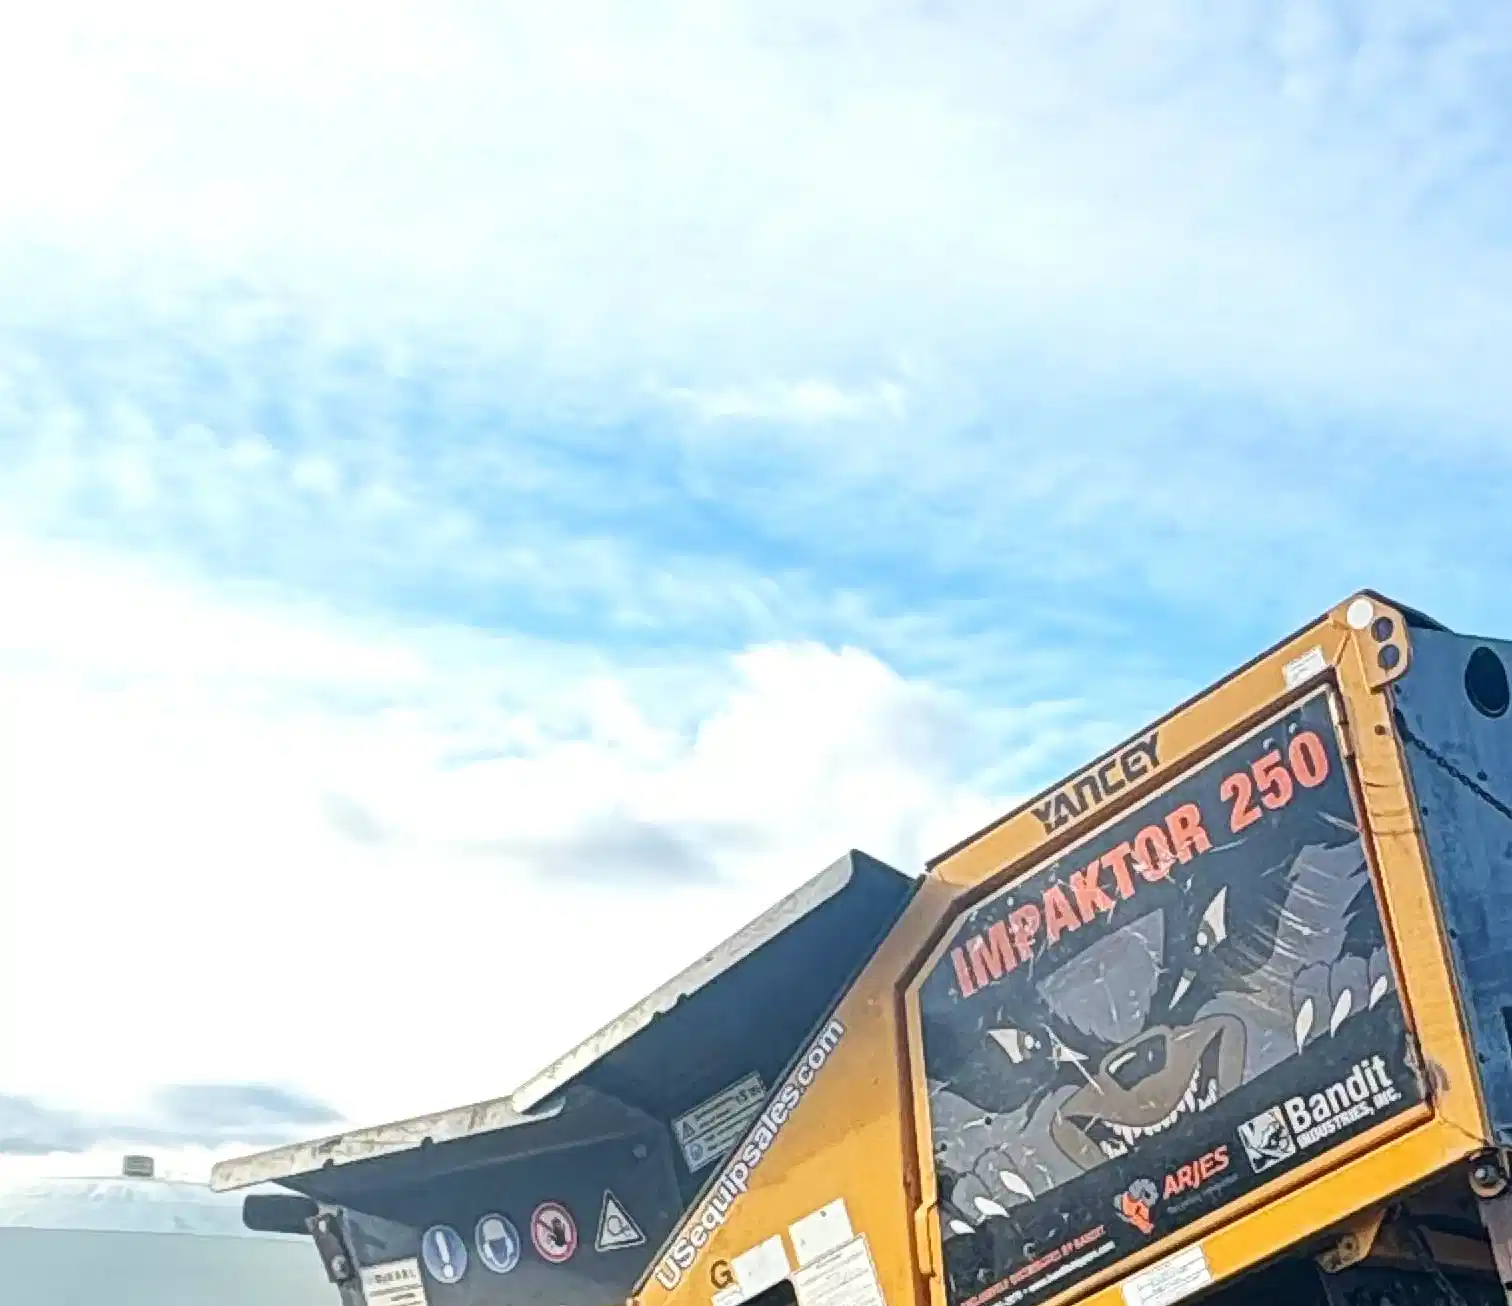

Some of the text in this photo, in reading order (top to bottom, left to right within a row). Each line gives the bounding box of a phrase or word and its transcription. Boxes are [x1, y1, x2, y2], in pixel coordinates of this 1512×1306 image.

[1029, 731, 1160, 836] YANCEY
[950, 730, 1331, 998] IMPAKTOR 250
[1285, 1054, 1394, 1134] Bandit
[1163, 1144, 1230, 1200] ARJES
